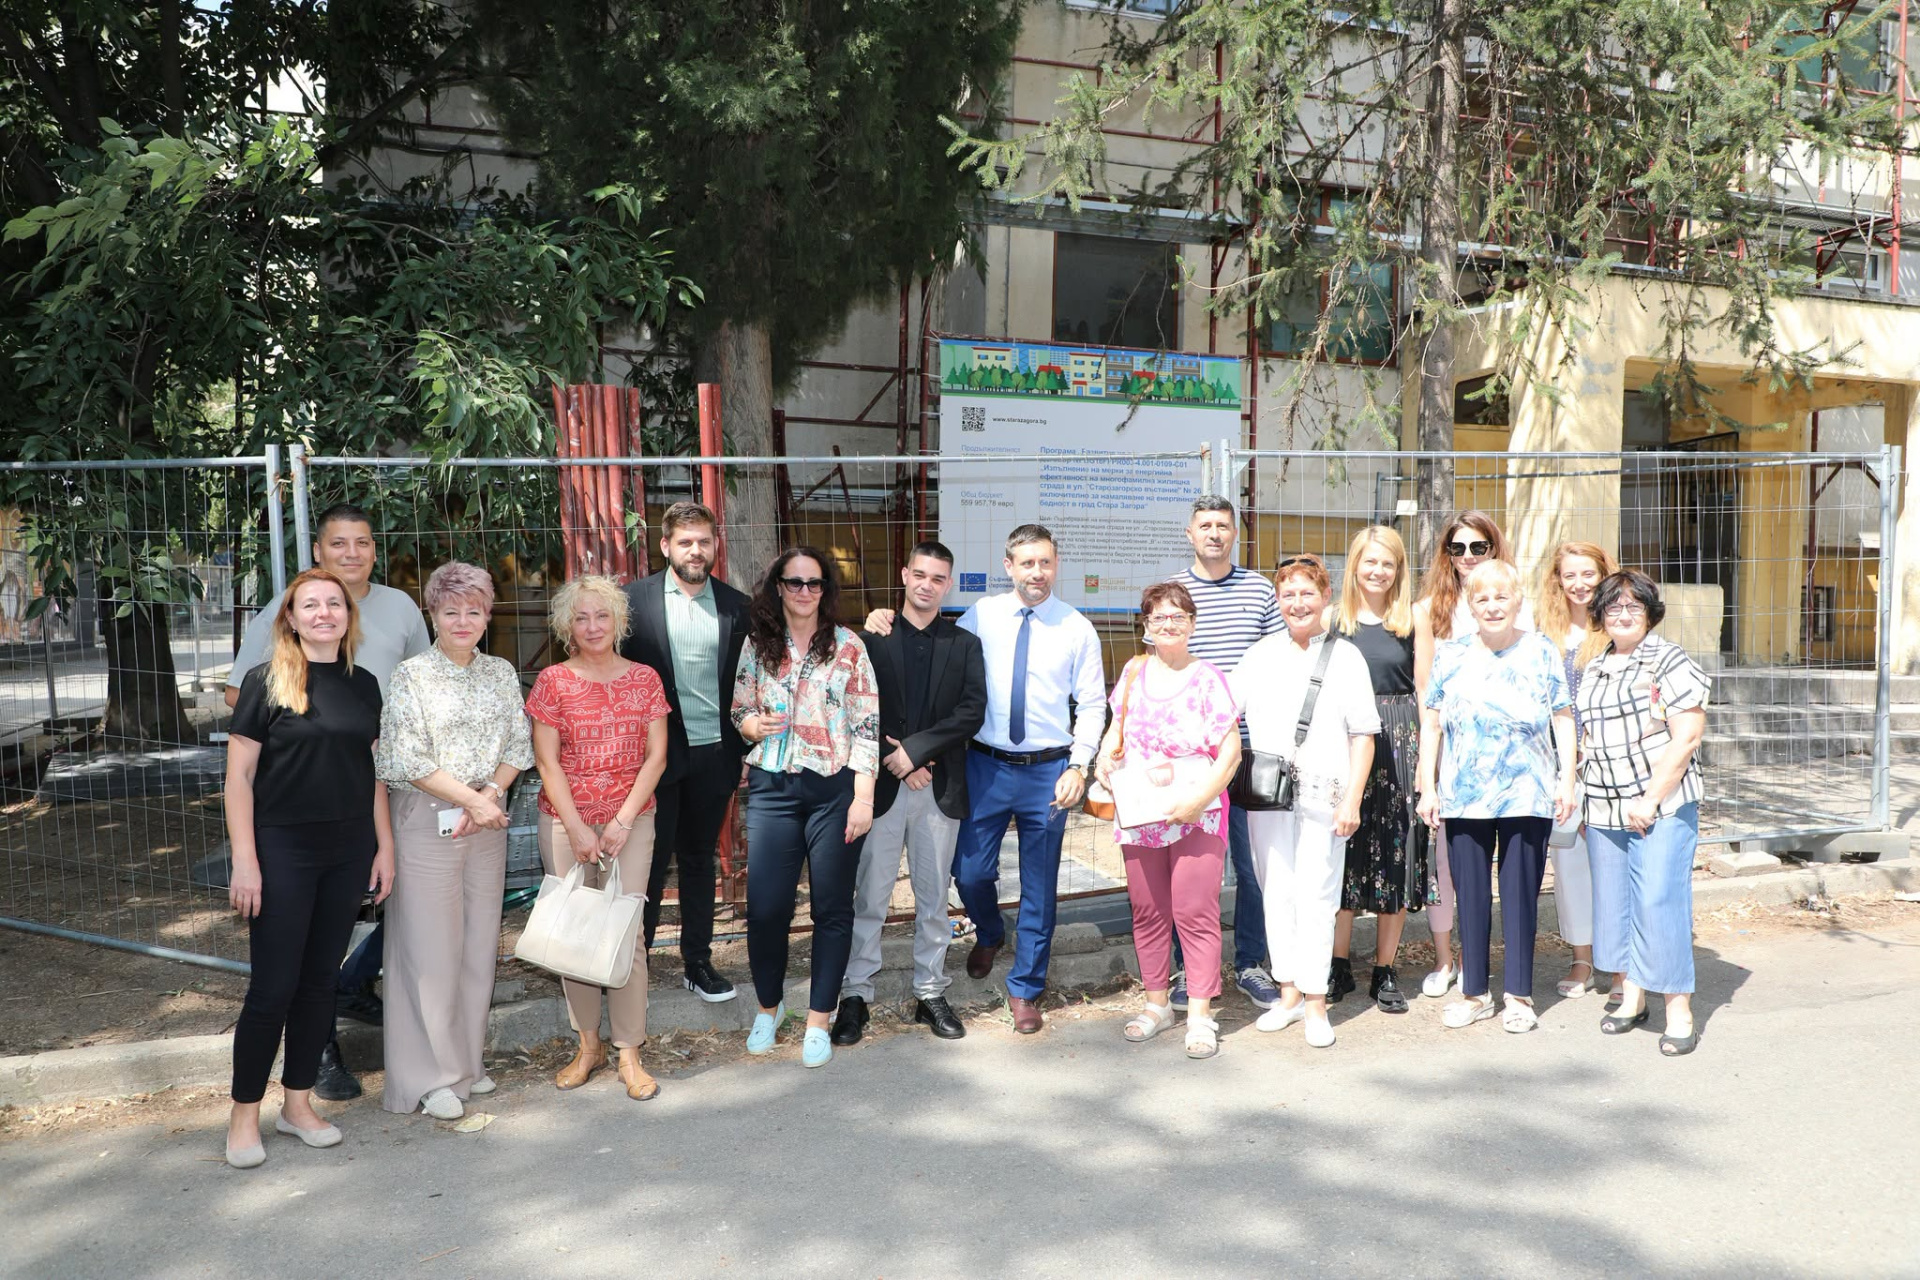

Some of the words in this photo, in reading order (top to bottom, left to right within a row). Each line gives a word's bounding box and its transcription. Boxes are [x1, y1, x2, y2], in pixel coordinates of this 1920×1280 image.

[992, 417, 1047, 425] www.starazagora.bg
[1040, 447, 1076, 455] Програма
[1096, 501, 1118, 509] Стара
